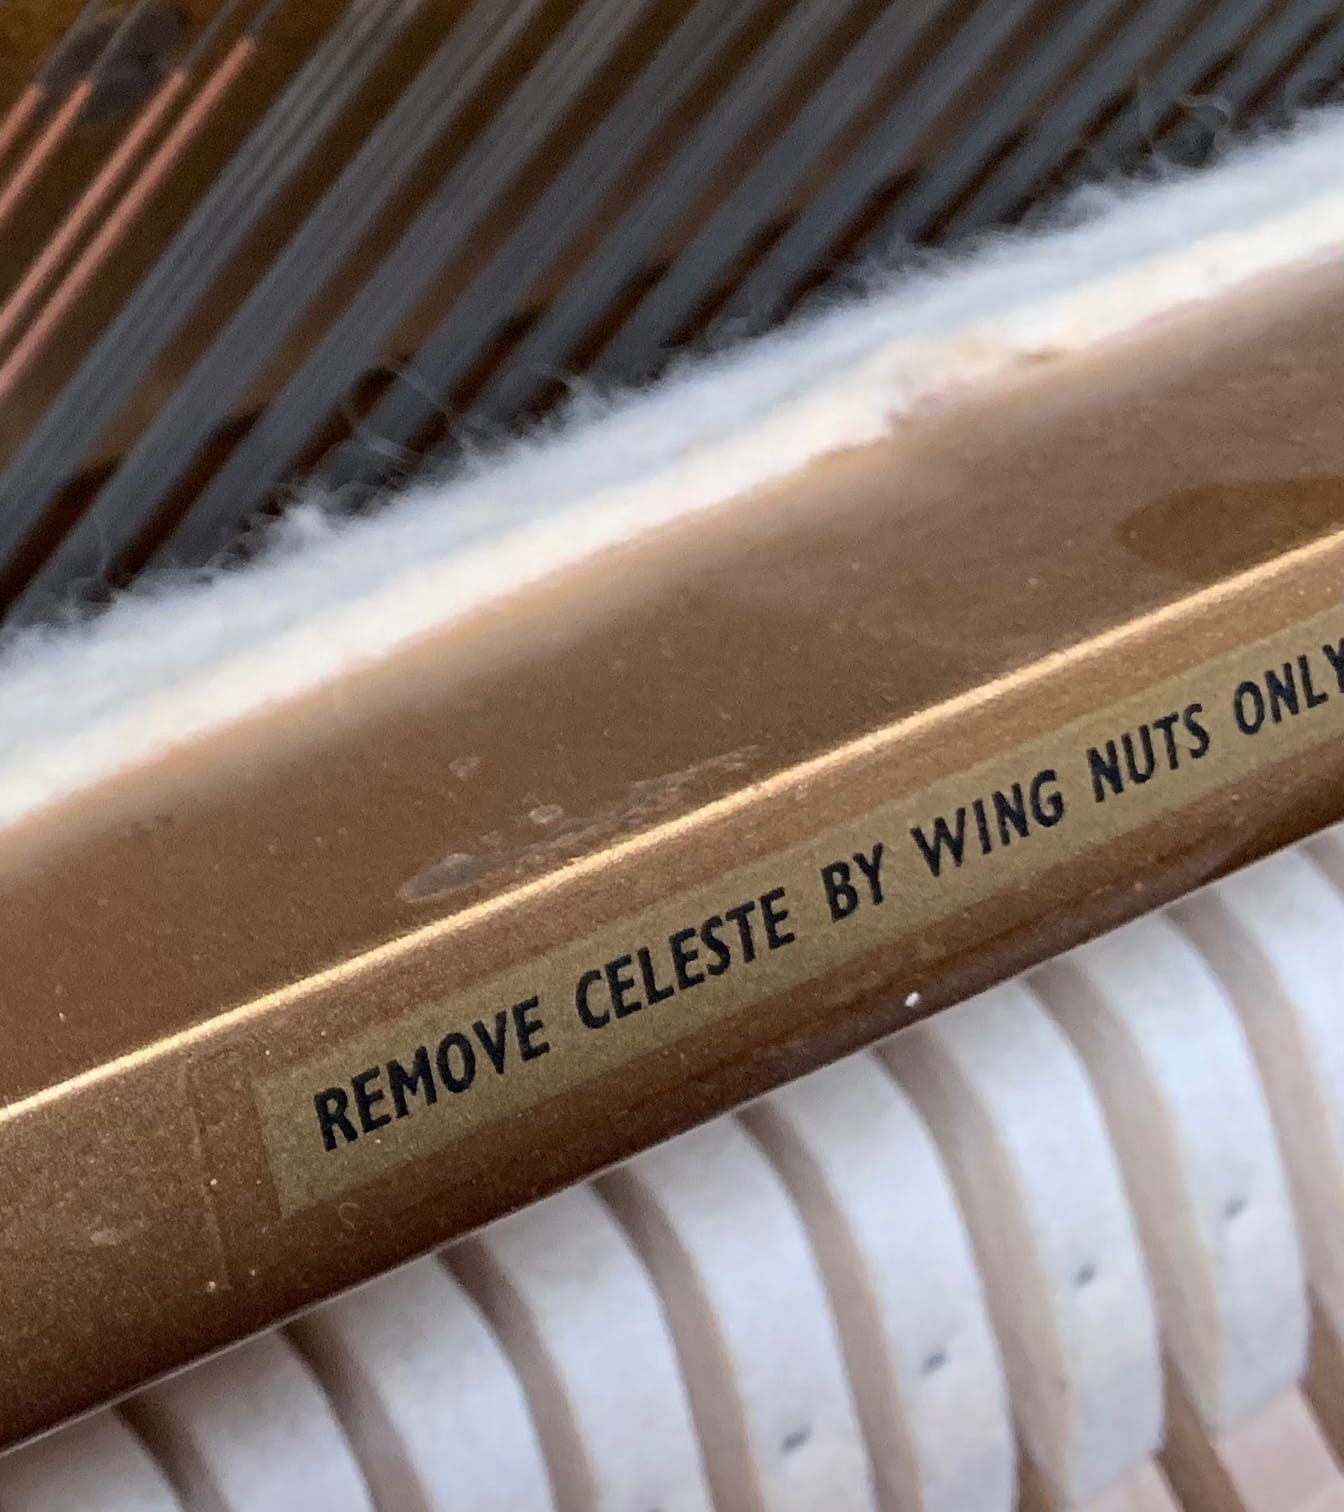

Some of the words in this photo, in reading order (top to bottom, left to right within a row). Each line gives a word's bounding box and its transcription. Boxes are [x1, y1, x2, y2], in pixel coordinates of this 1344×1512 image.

[313, 996, 550, 1152] REMOVE
[575, 888, 796, 1030] CELESTE
[821, 844, 886, 922] BY
[909, 768, 1065, 878] WING
[1086, 702, 1211, 803] NUTS
[1232, 635, 1344, 736] ONLY
